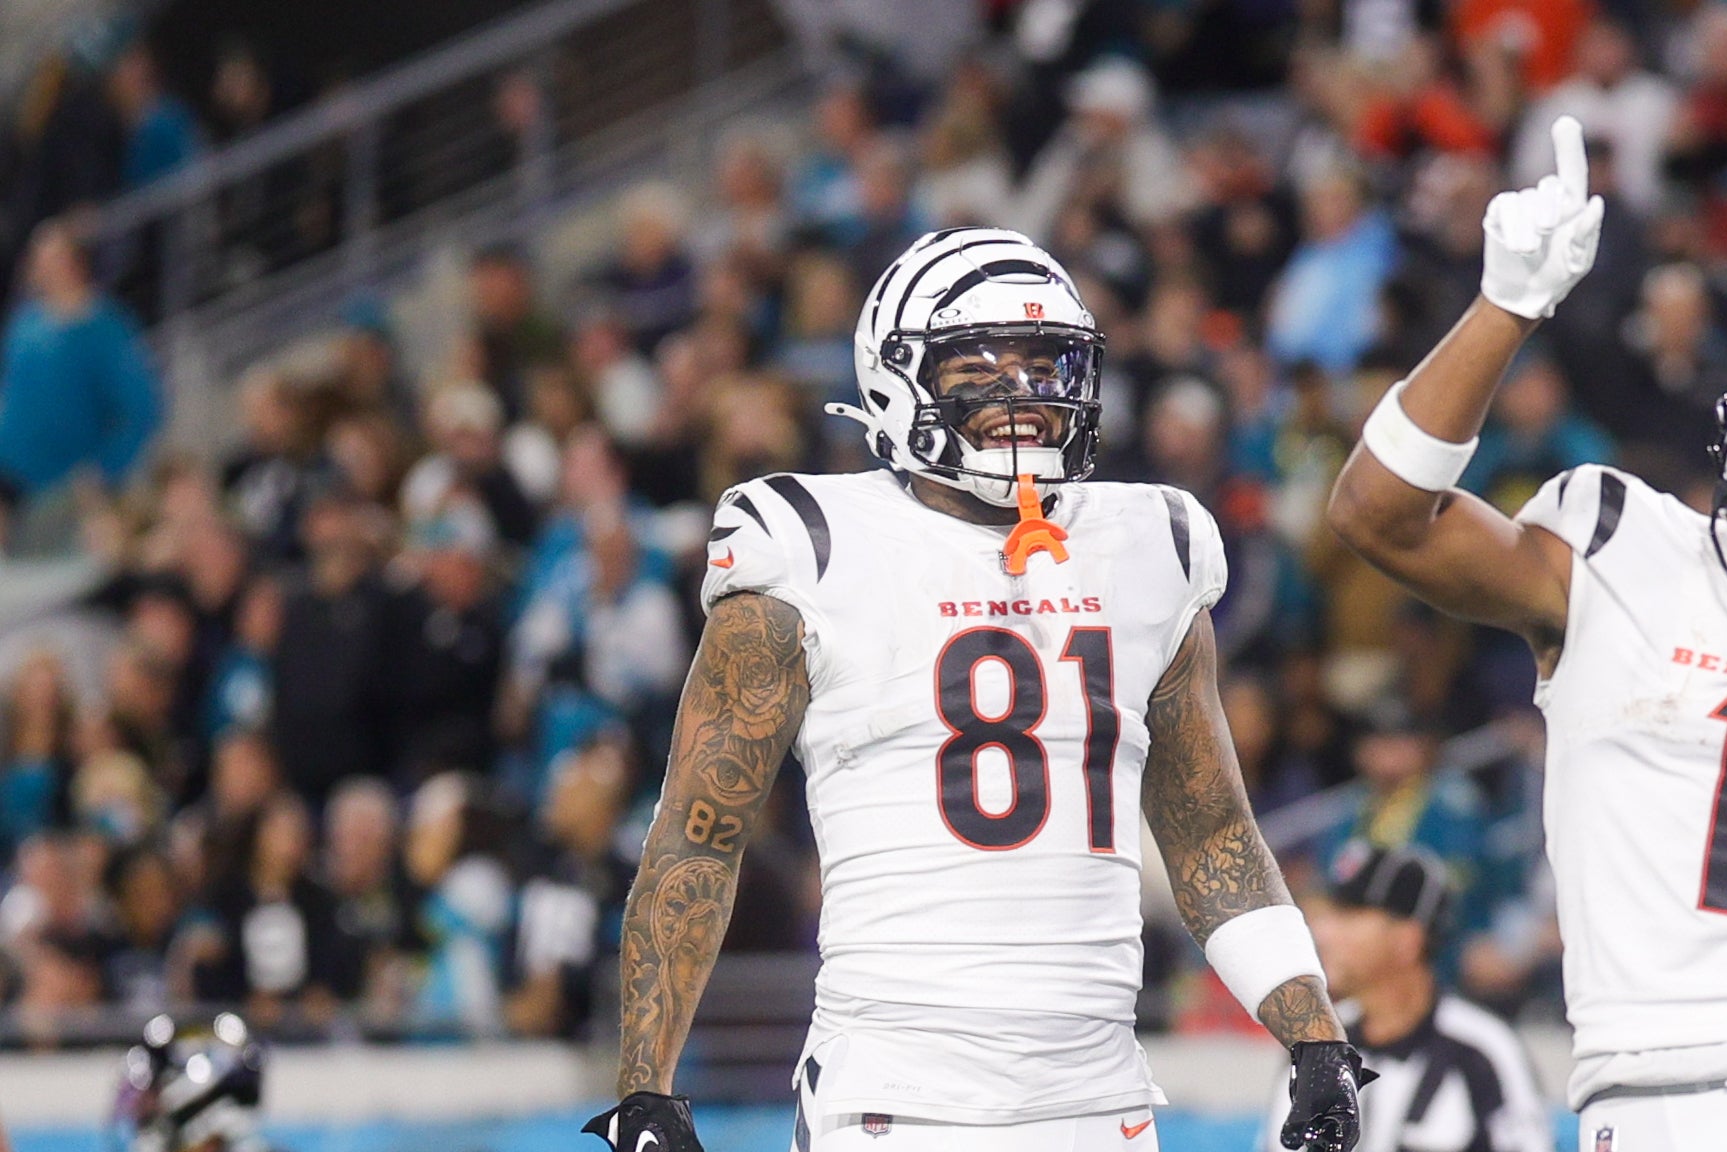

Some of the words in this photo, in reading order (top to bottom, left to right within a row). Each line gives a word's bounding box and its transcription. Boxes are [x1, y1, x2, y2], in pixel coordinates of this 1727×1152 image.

[938, 597, 1102, 617] BENGALS
[934, 626, 1121, 854] 81
[685, 799, 743, 853] 82
